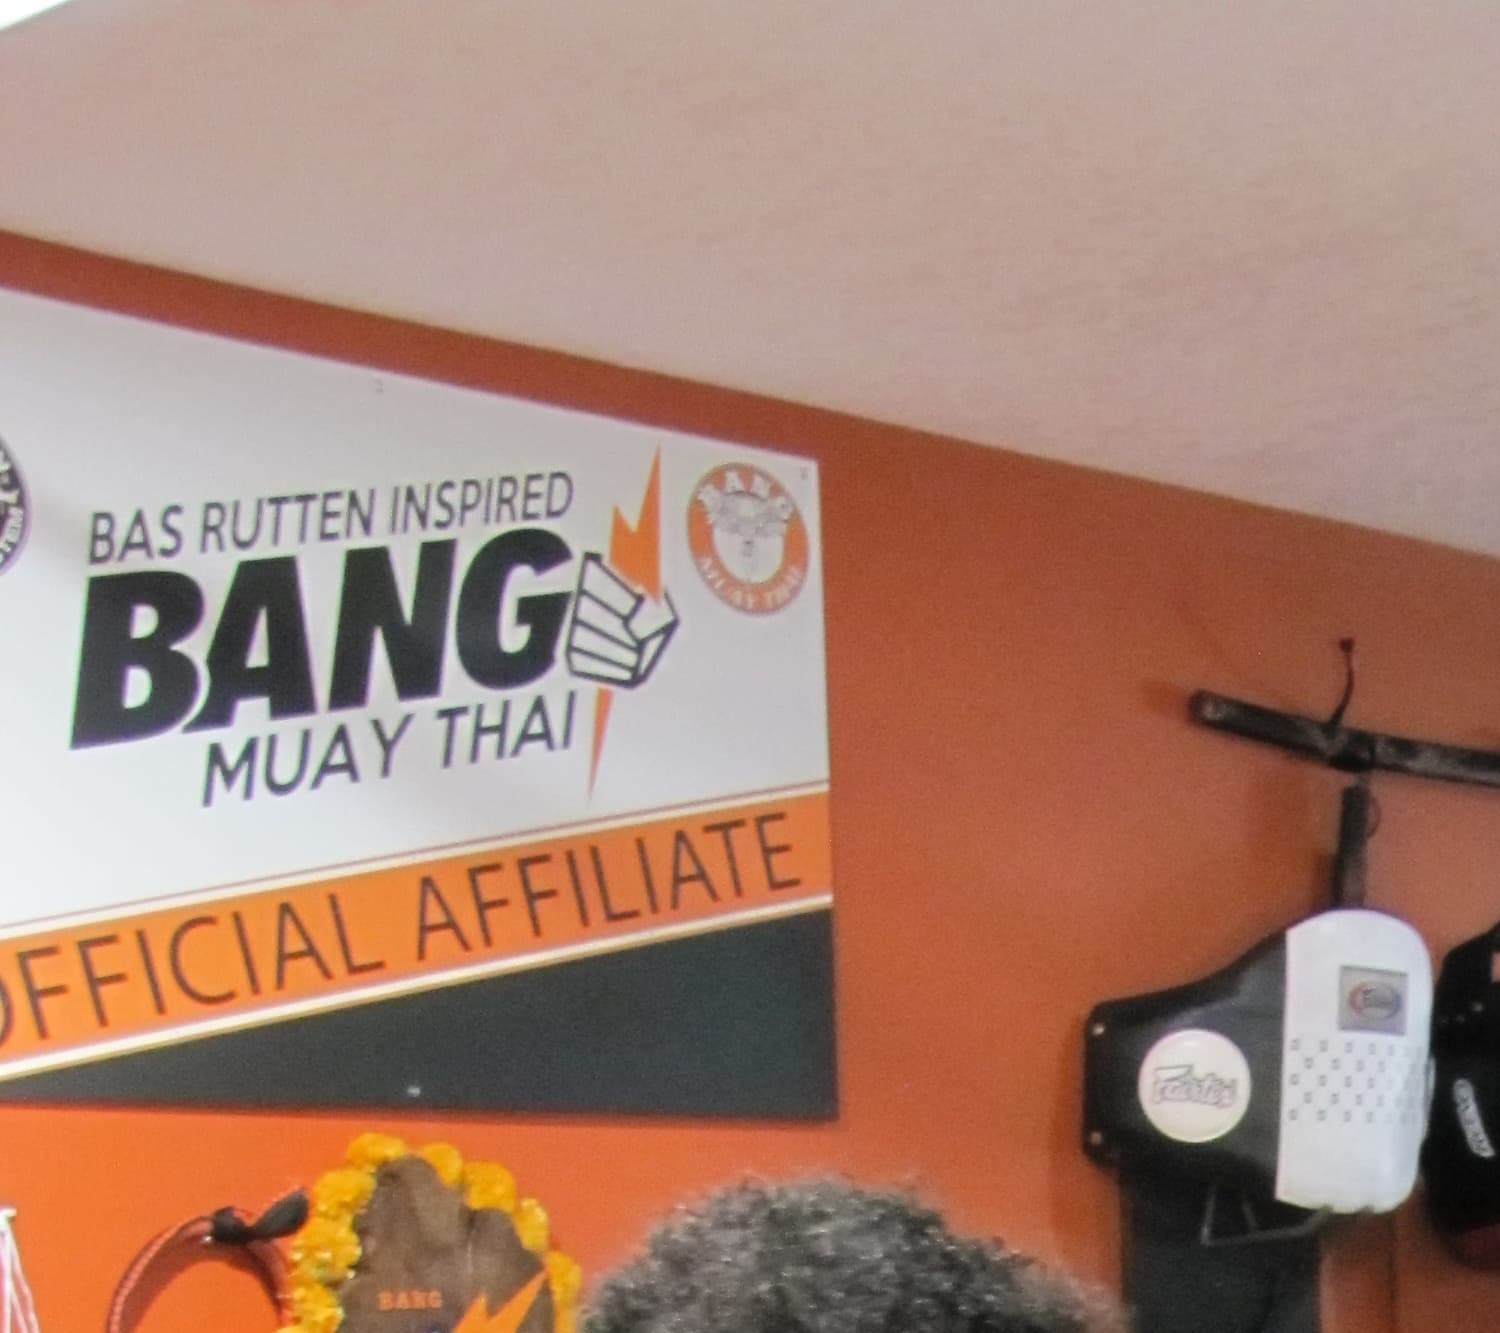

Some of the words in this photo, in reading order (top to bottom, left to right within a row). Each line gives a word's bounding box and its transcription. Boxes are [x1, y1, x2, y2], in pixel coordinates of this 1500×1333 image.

[89, 503, 183, 565] BAS
[202, 487, 374, 553] RUTTEN
[390, 472, 573, 528] INSPIRED
[69, 527, 575, 750] BANG
[202, 713, 416, 807] MUAY
[437, 691, 576, 768] THAI
[416, 811, 802, 960] AFFILIATE
[379, 1290, 441, 1311] BANG
